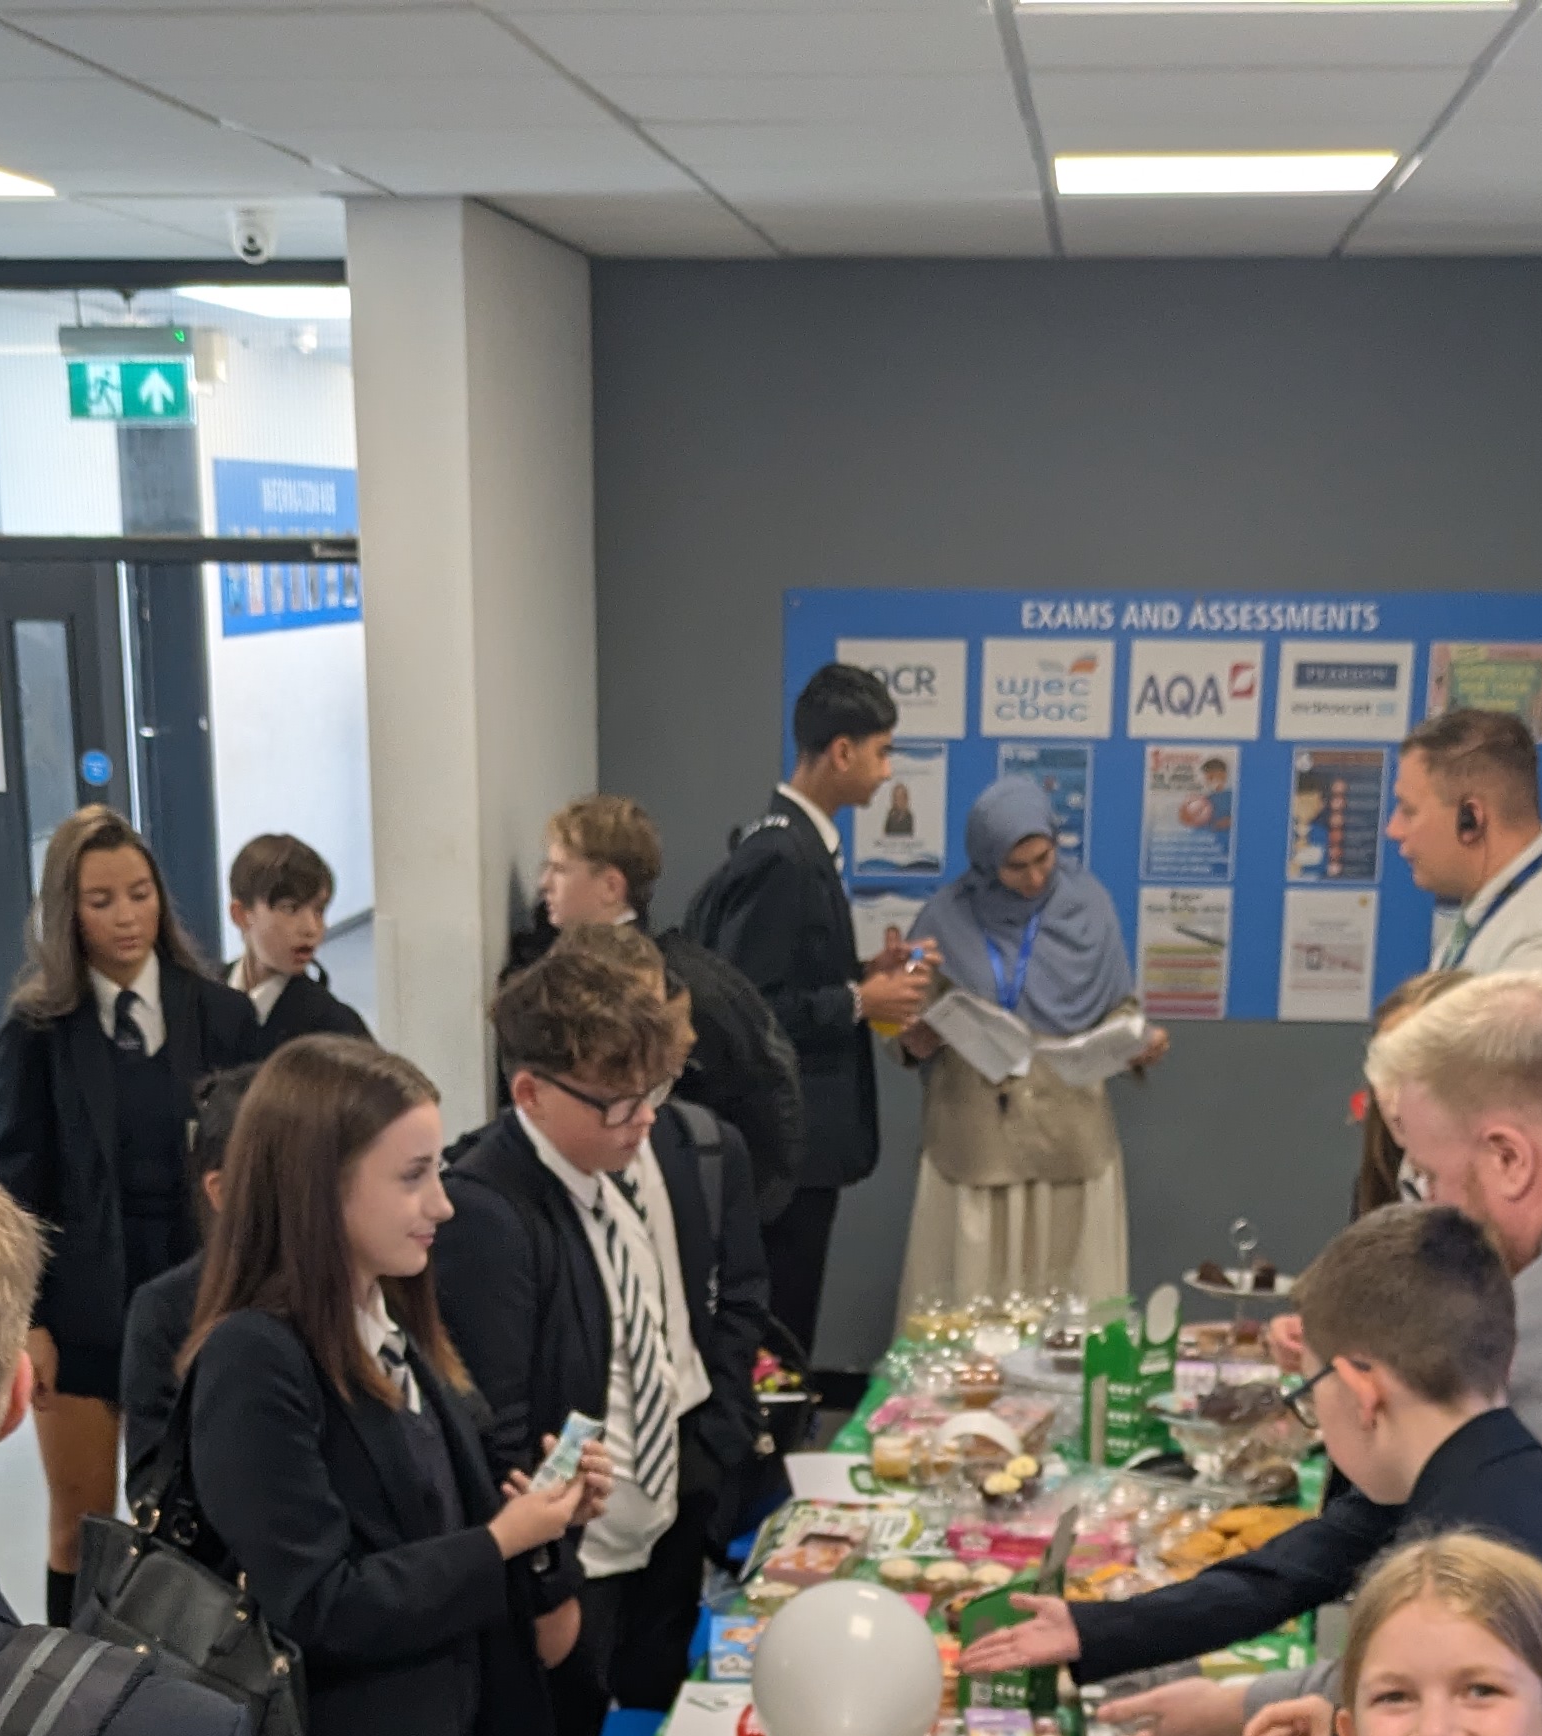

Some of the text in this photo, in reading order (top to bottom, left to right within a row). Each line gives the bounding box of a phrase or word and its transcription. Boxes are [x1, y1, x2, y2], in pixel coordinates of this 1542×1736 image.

[1021, 602, 1380, 632] EXAMS AND ASSESSMENTS
[995, 676, 1091, 701] wjec
[1134, 675, 1224, 717] AQA
